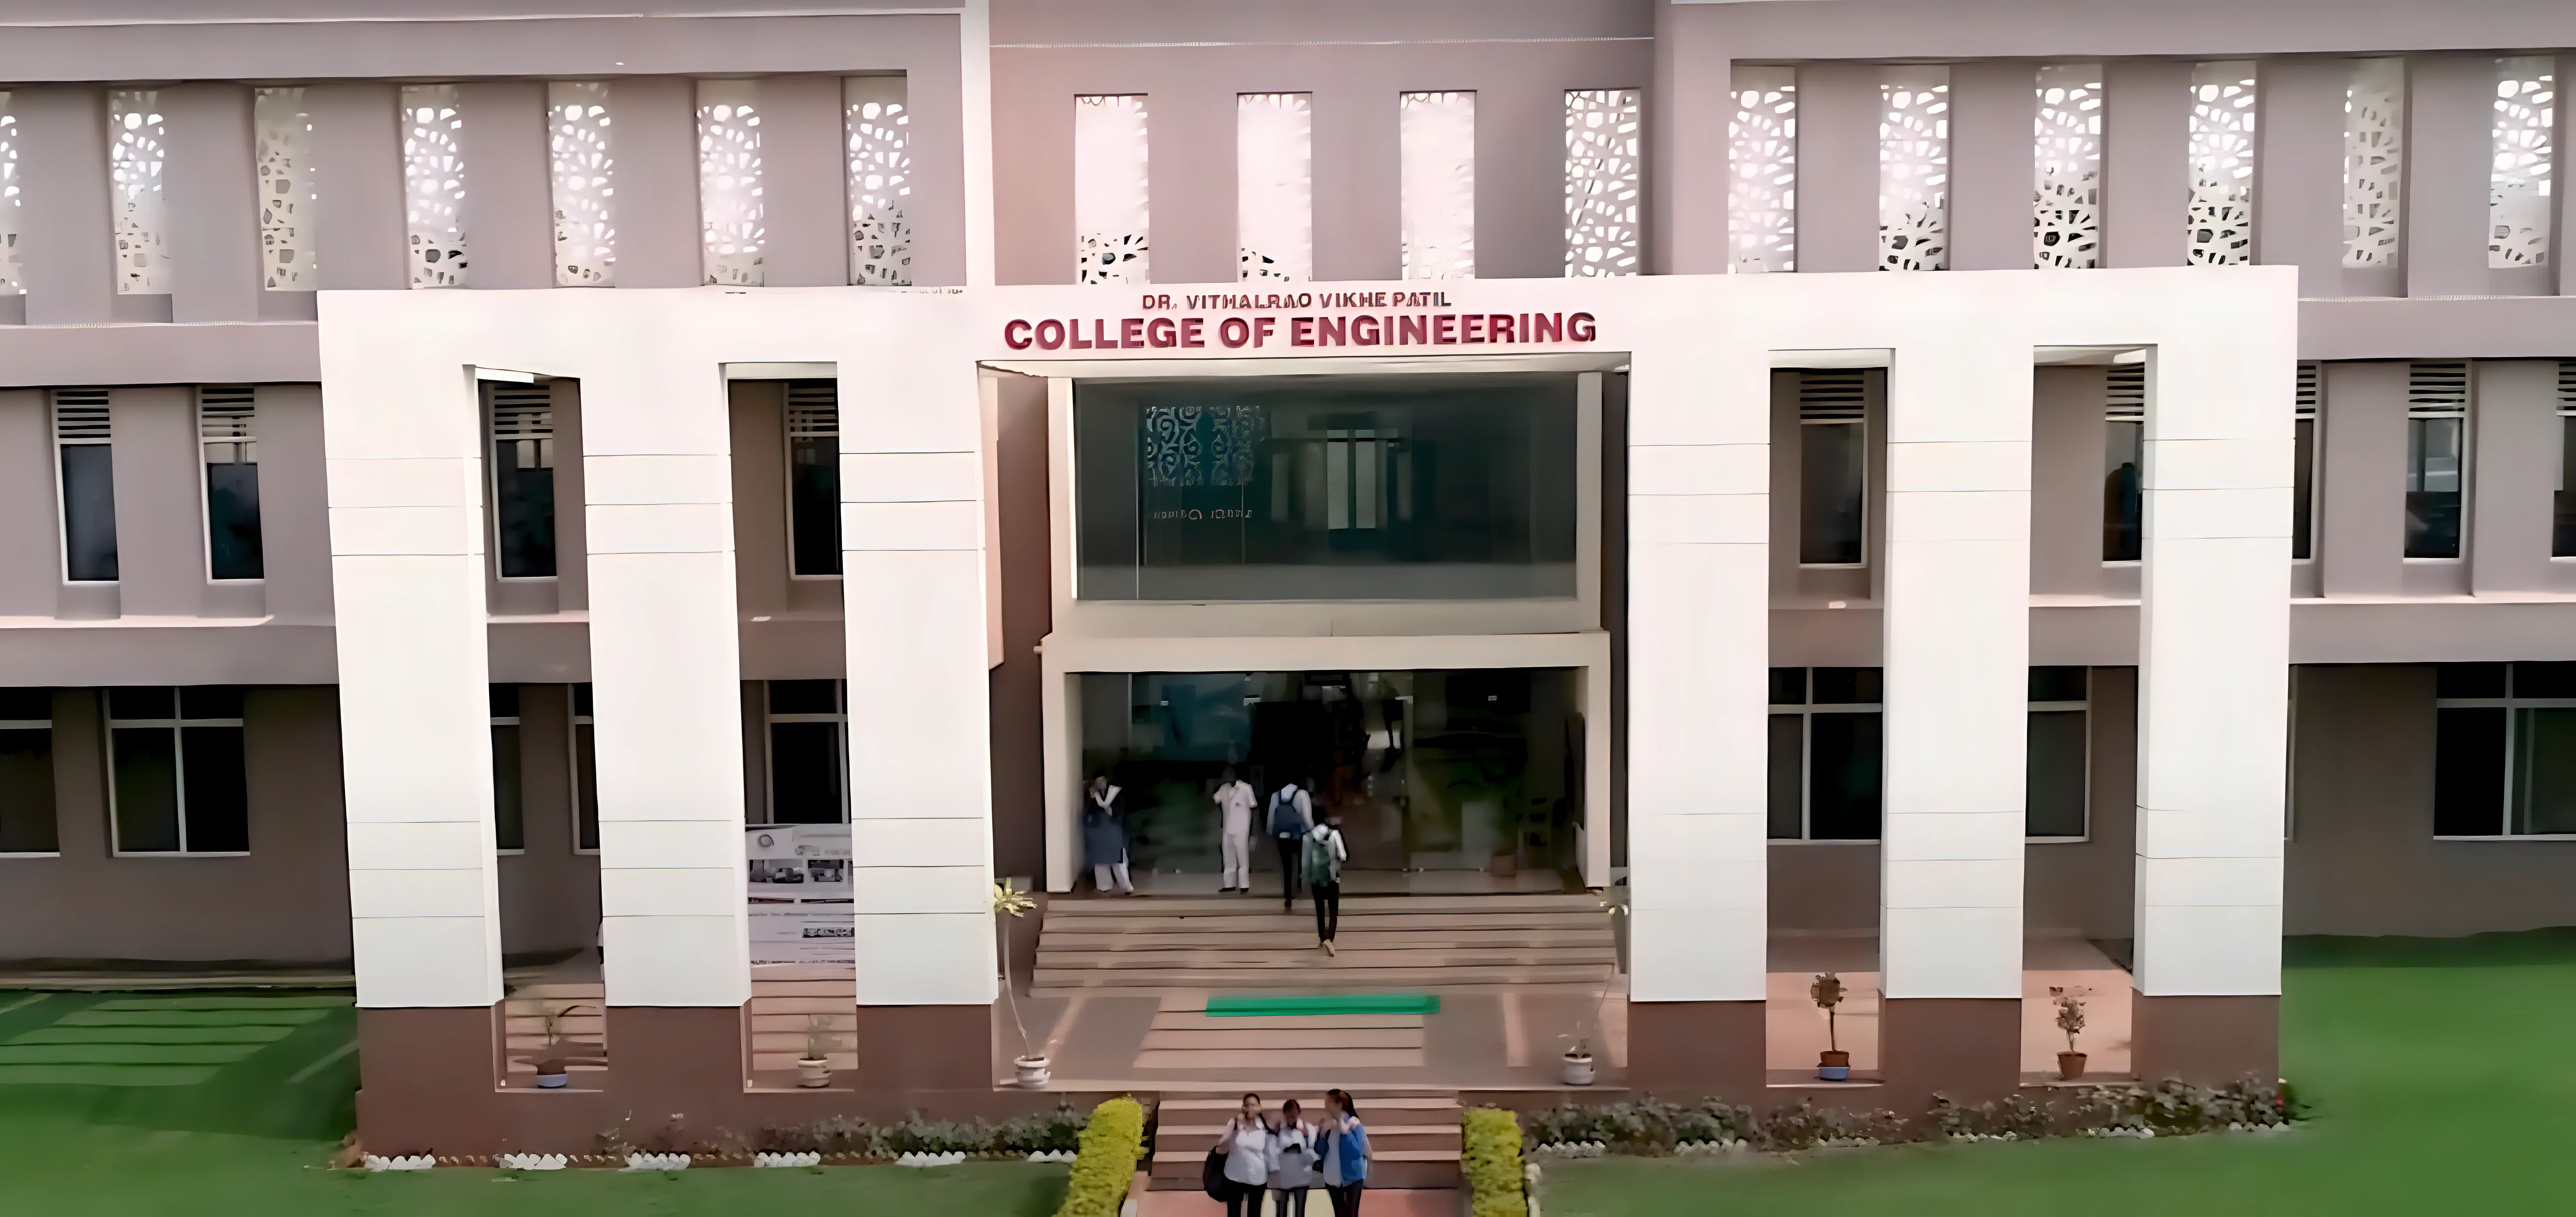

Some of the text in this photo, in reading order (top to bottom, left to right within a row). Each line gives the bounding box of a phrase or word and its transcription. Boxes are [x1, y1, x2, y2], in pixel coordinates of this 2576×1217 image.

[1142, 294, 1177, 310] DR.
[1319, 292, 1388, 308] VIKHE
[1392, 291, 1452, 307] PATIL
[1004, 312, 1596, 350] COLLEGE OF ENGINEERING
